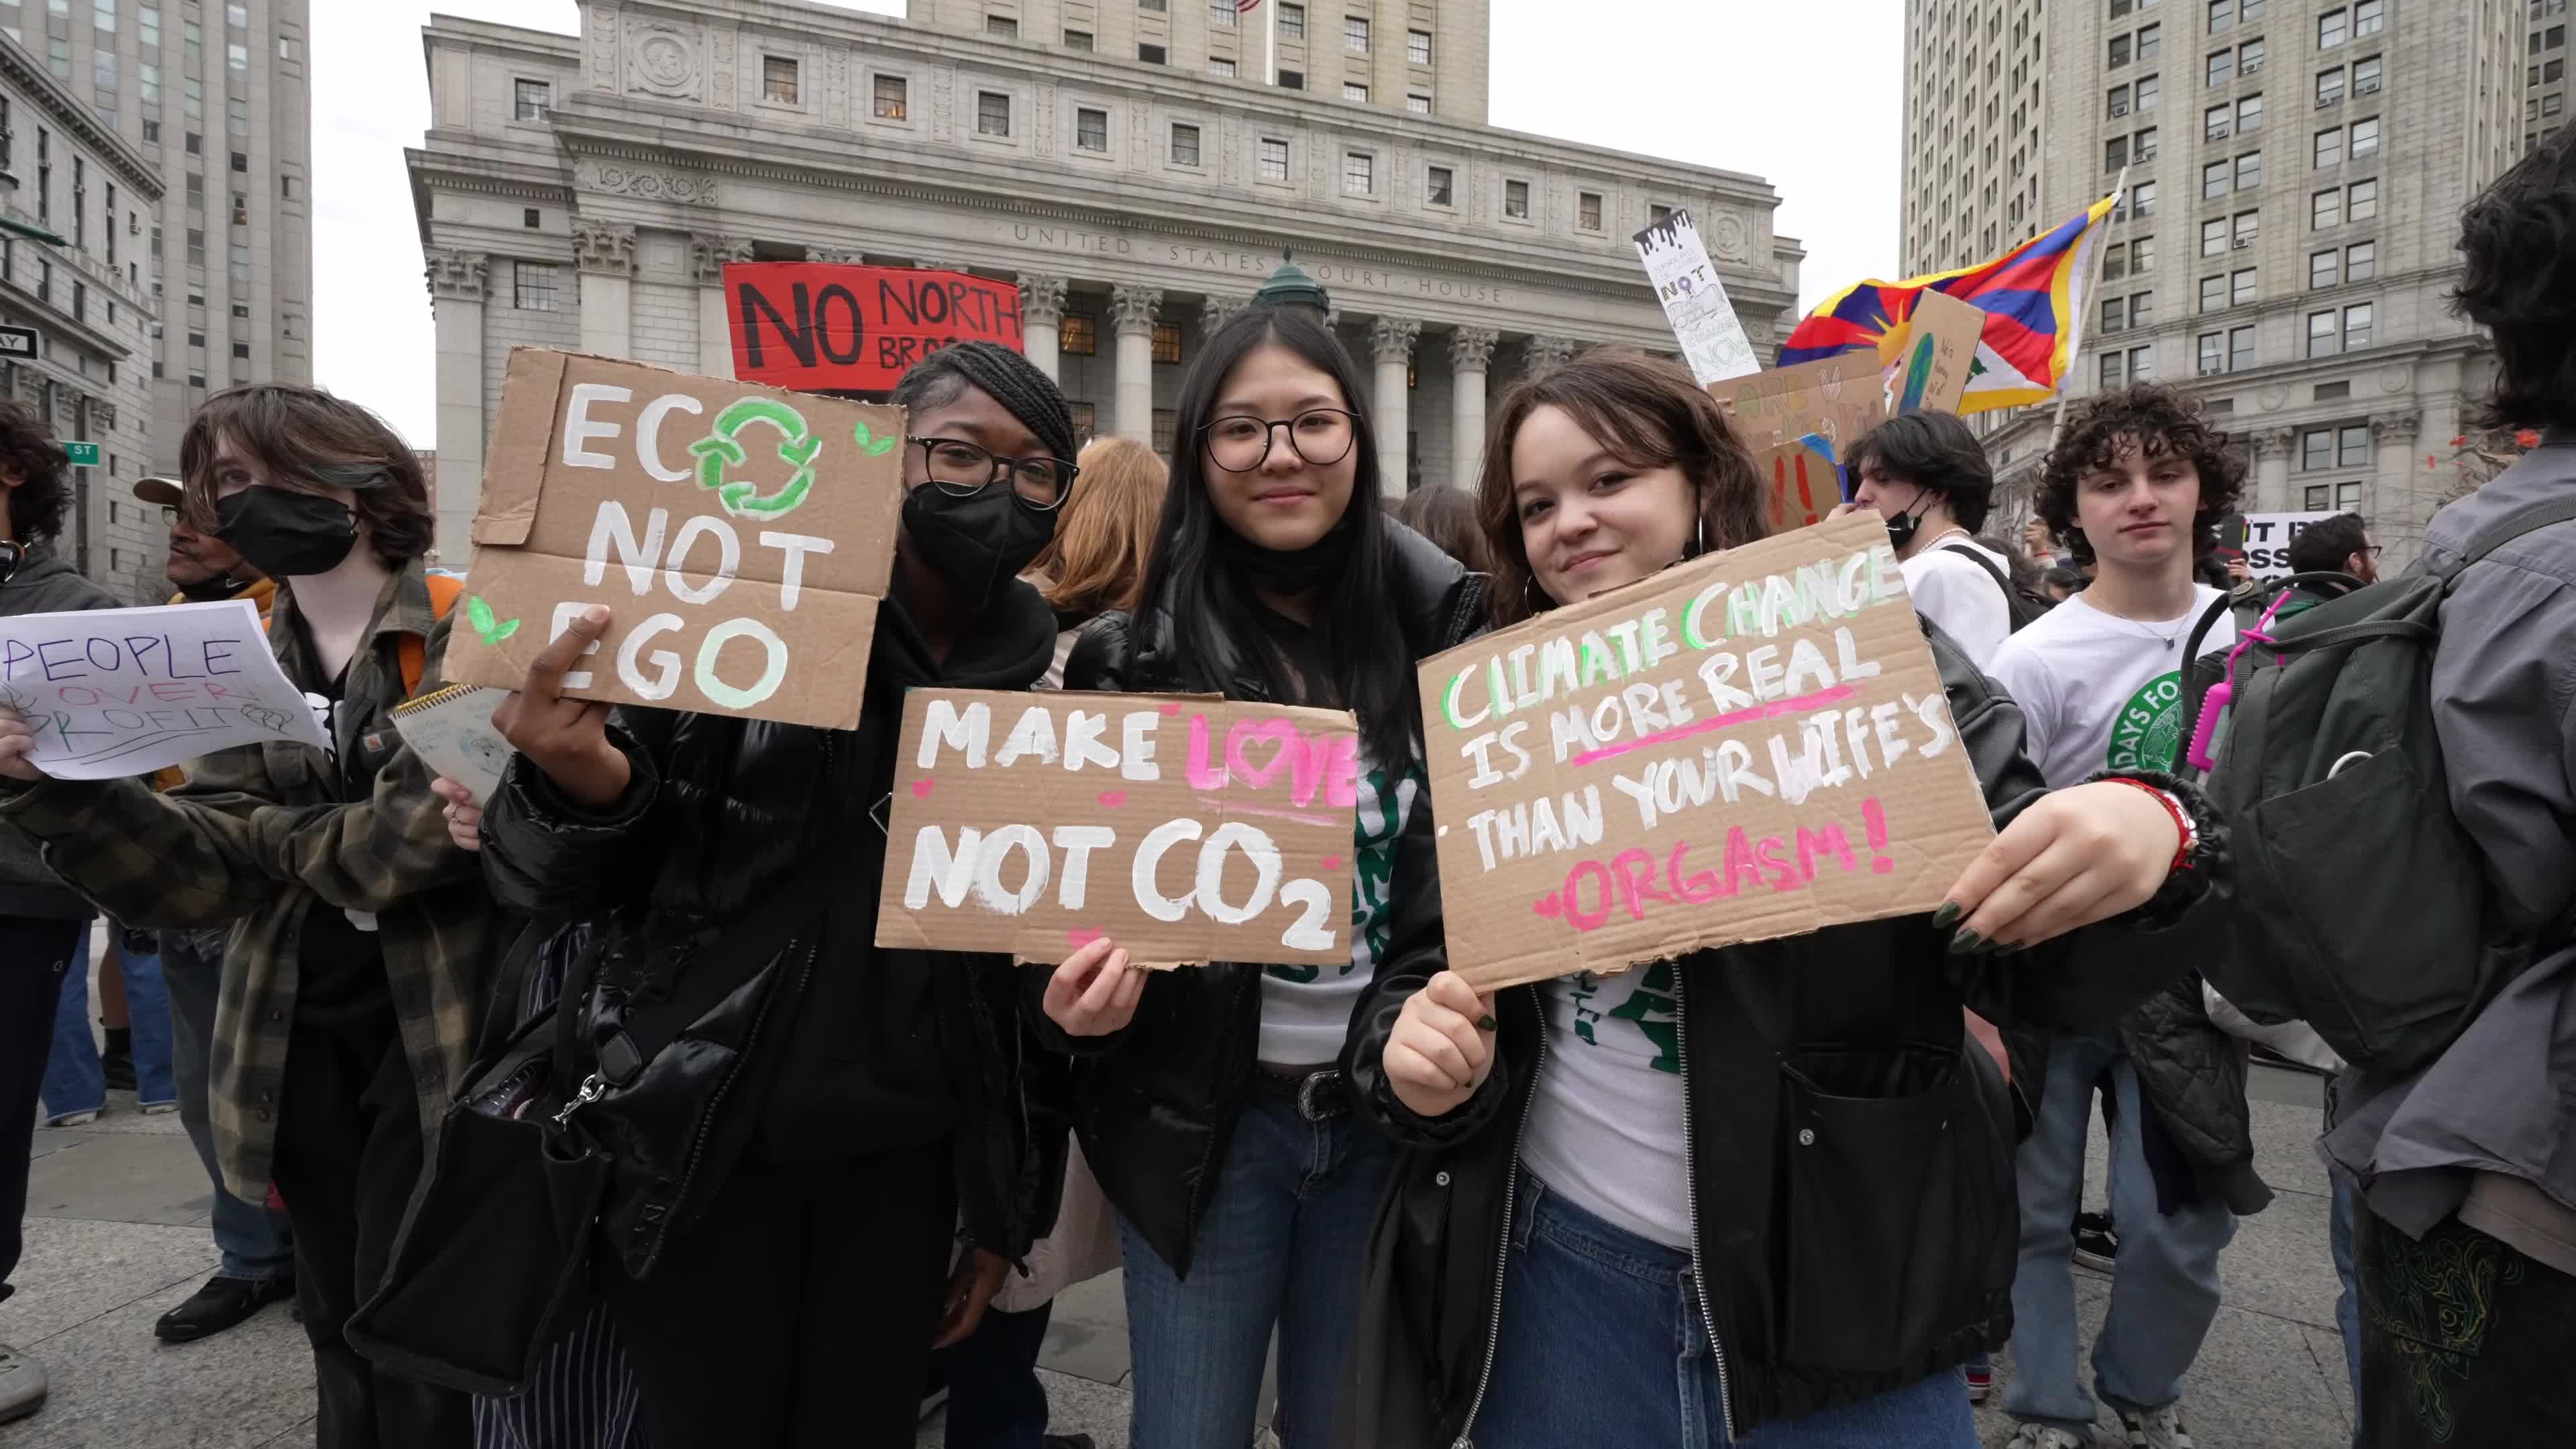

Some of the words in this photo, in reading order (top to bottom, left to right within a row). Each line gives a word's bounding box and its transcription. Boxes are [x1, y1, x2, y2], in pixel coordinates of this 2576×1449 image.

[1014, 224, 1131, 254] UNITED
[1169, 246, 1265, 272] STATES
[1297, 263, 1392, 288] OURT
[1419, 278, 1503, 303] HOUSE
[1660, 264, 1705, 301] NOT
[738, 281, 864, 370] NO
[878, 278, 1022, 339] NORTH
[74, 445, 91, 456] ST
[583, 500, 835, 611] NOT
[3, 634, 241, 682] PEOPLE
[549, 601, 788, 710] EGO
[1440, 607, 1678, 731] CLIMATE
[1680, 545, 1907, 651] CHANGE
[24, 706, 239, 753] PROFIT
[58, 682, 261, 706] OVER
[1461, 720, 1532, 790] IS
[1550, 679, 1695, 765] MORE
[1697, 627, 1881, 716] REAL
[2143, 676, 2182, 710] FO
[917, 699, 1160, 781] MAKE
[1185, 712, 1358, 808] LOVE
[1467, 784, 1604, 873] THAN
[1612, 739, 1774, 830] YOUR
[1768, 692, 1956, 804] WIFE'S
[904, 824, 1116, 916] NOT
[1562, 797, 1894, 932] ORGASM!
